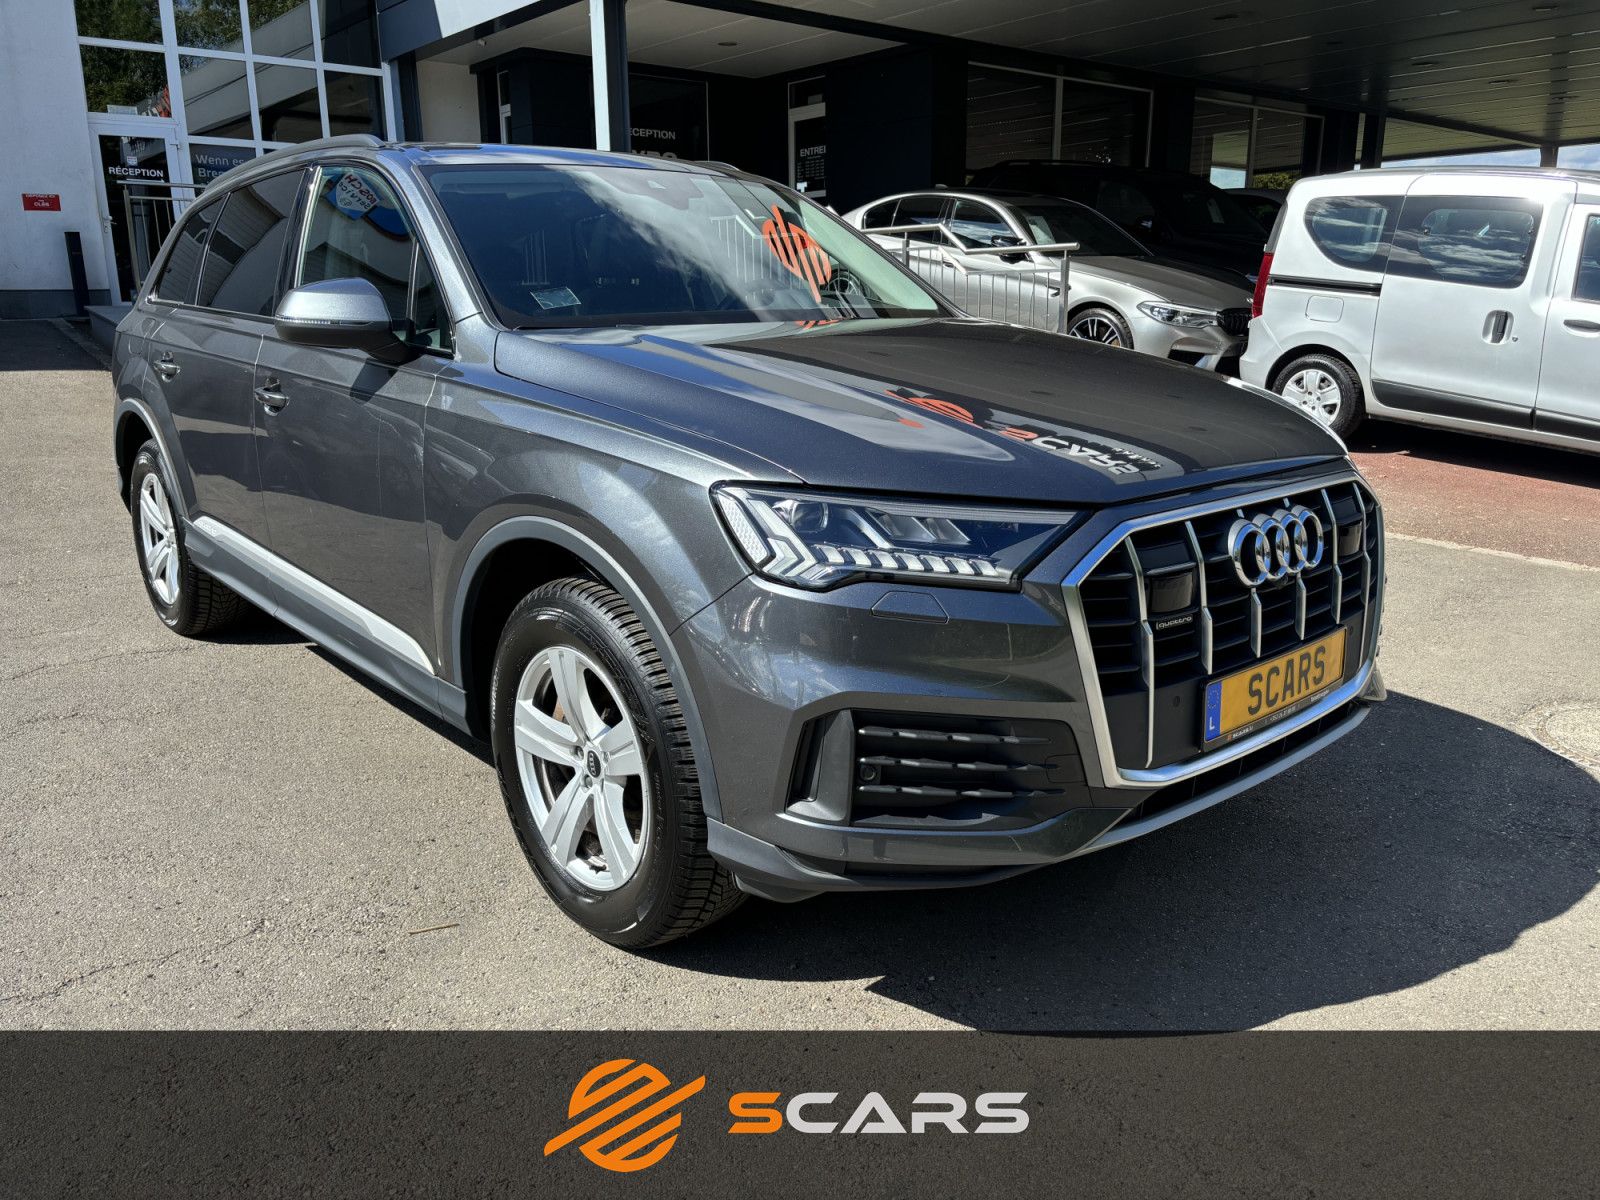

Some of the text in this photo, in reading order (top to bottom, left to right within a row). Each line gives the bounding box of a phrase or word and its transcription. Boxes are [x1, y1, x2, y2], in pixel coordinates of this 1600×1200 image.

[195, 155, 229, 166] Wenn
[108, 165, 164, 177] RÉCEPTION
[1248, 646, 1326, 715] SCARS
[1208, 716, 1216, 731] L
